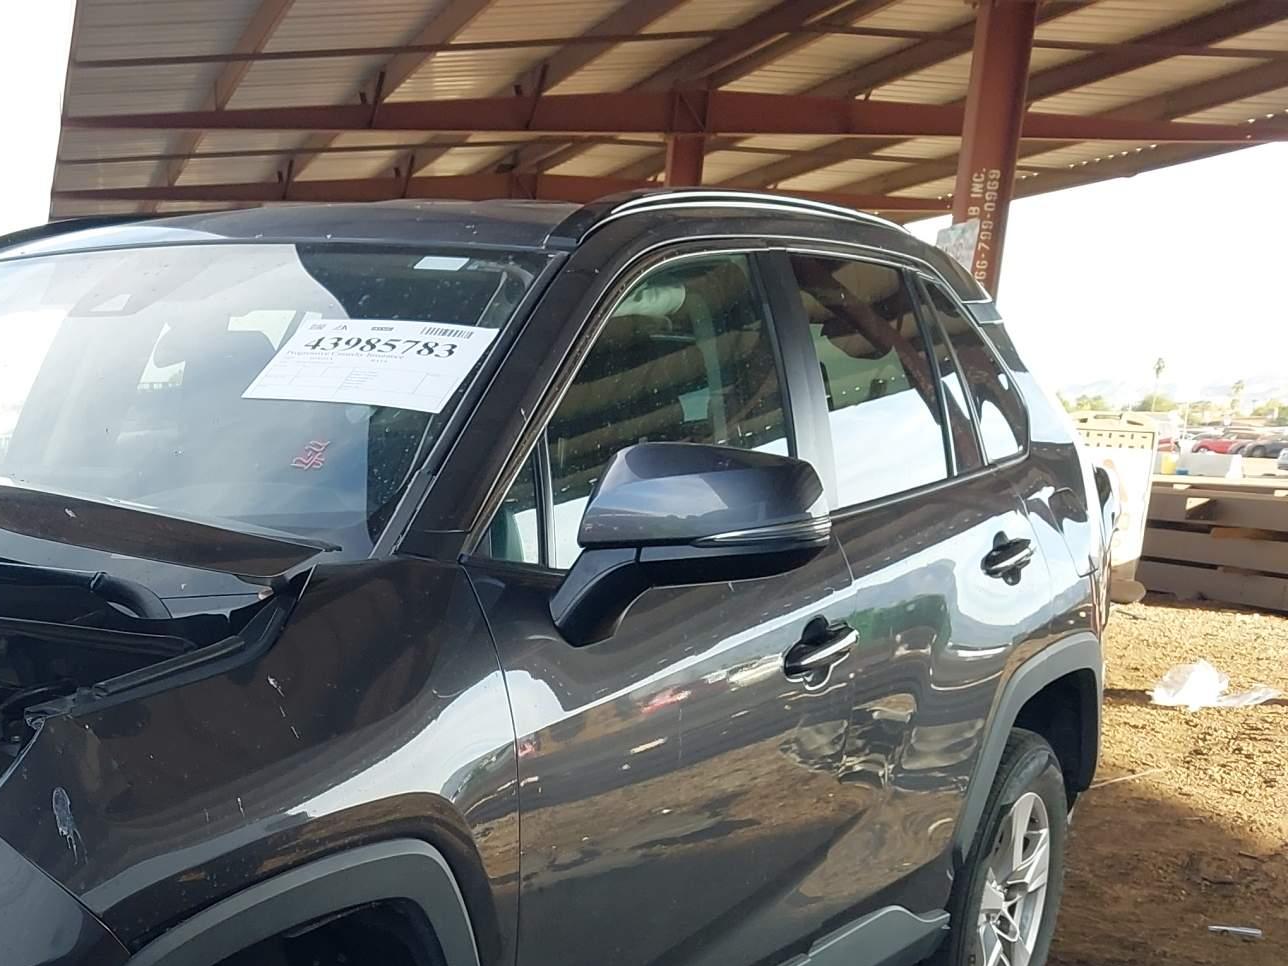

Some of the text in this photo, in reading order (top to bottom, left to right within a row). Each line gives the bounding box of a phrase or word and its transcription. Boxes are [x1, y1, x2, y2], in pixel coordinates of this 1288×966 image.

[971, 167, 987, 198] INC.
[974, 169, 1001, 287] 66-799-0969
[304, 337, 458, 358] 43985783
